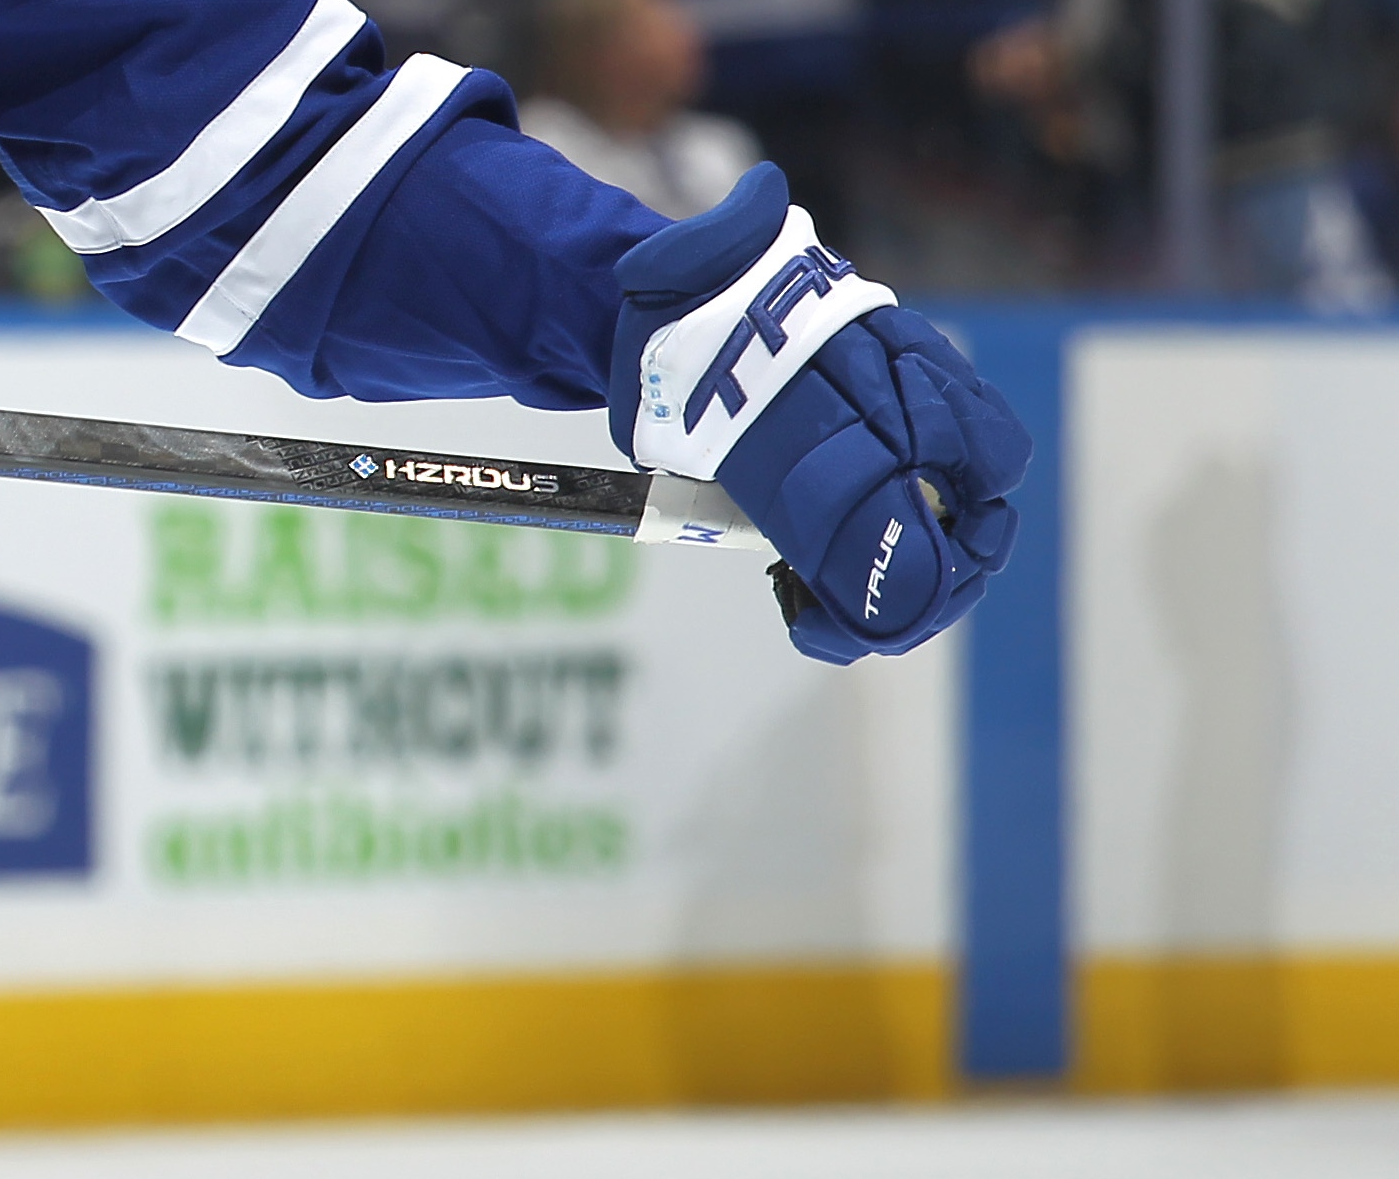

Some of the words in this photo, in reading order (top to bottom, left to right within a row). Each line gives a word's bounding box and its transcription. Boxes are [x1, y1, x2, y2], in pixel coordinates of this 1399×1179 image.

[683, 244, 857, 436] TRU
[385, 458, 559, 494] HZRDUS
[866, 518, 902, 618] TRUE
[151, 648, 628, 766] WITHOUT
